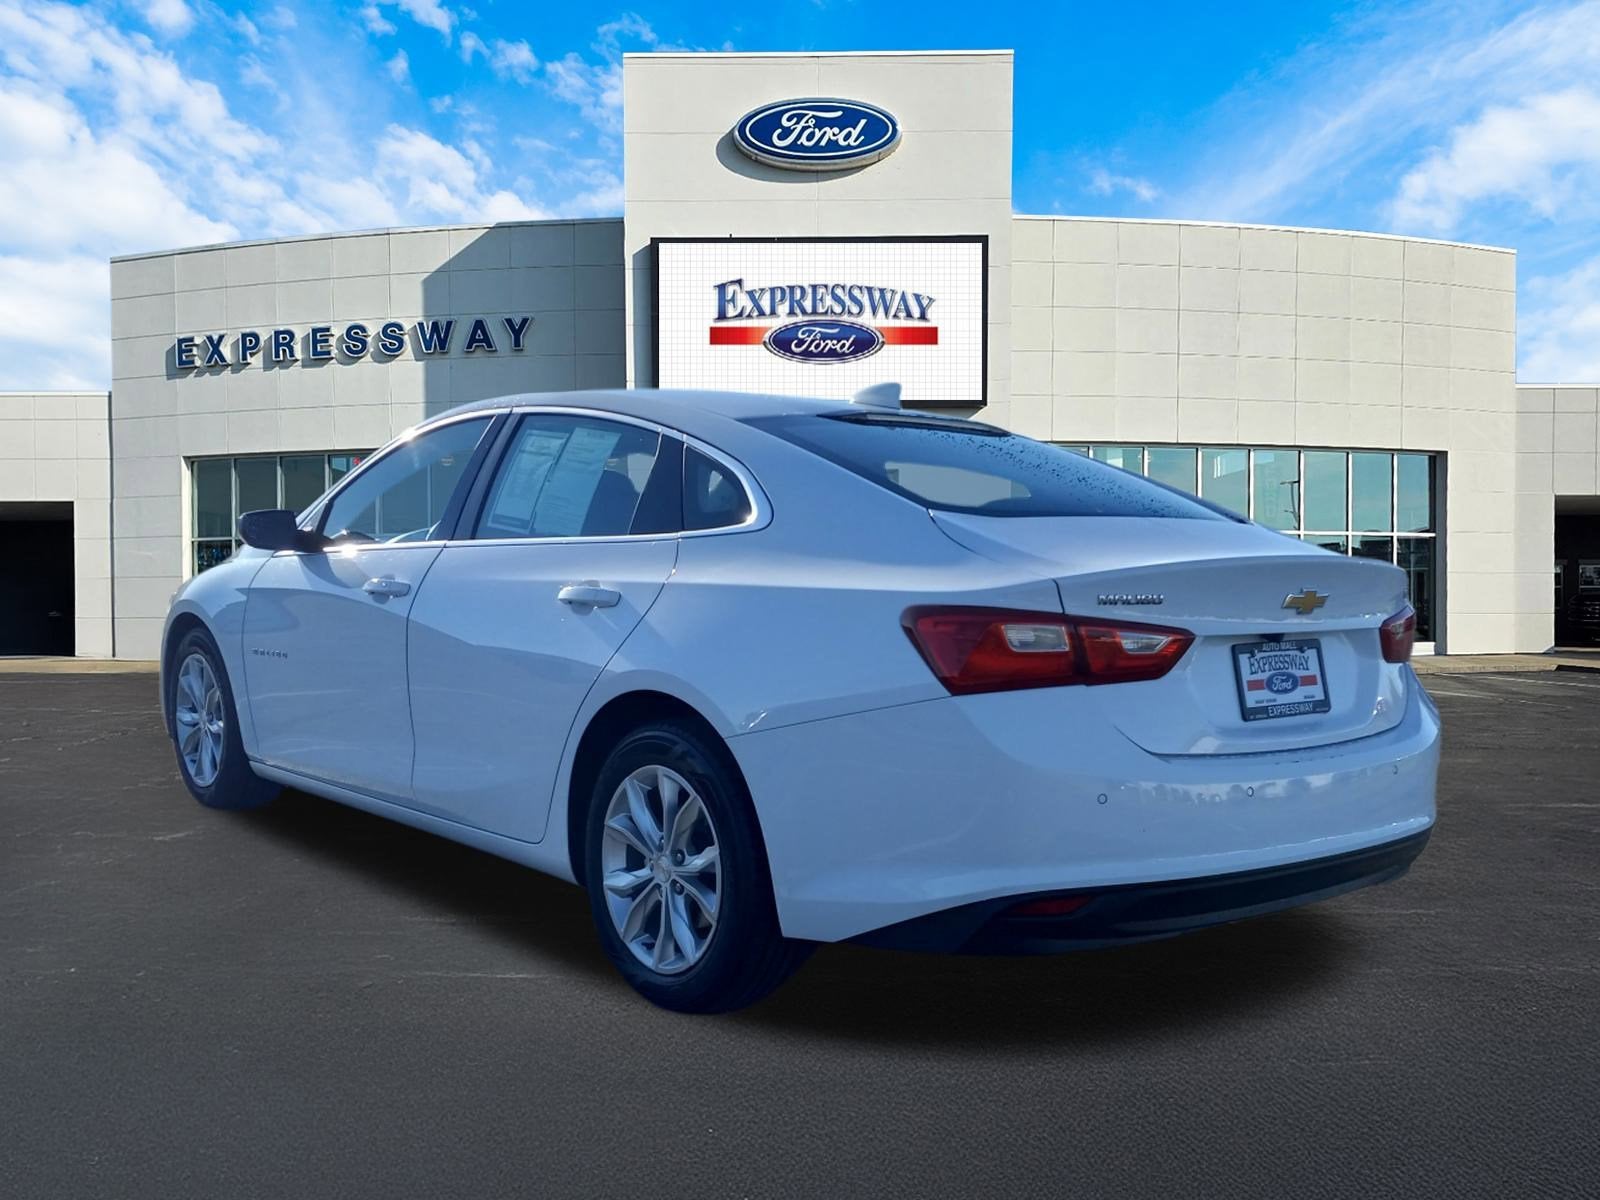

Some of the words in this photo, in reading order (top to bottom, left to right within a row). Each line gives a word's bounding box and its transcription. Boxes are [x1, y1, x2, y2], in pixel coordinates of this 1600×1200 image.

[772, 110, 865, 147] Ford
[713, 278, 936, 322] EXPRESSWAY
[175, 315, 532, 368] EXPRESSWAY
[791, 327, 855, 354] Ford
[1097, 594, 1165, 606] MALIBU
[1262, 642, 1279, 651] AUTO
[1248, 653, 1310, 675] EXPRESSWAY
[1272, 675, 1293, 690] Ford
[1268, 703, 1313, 716] EXPRESSWAY
